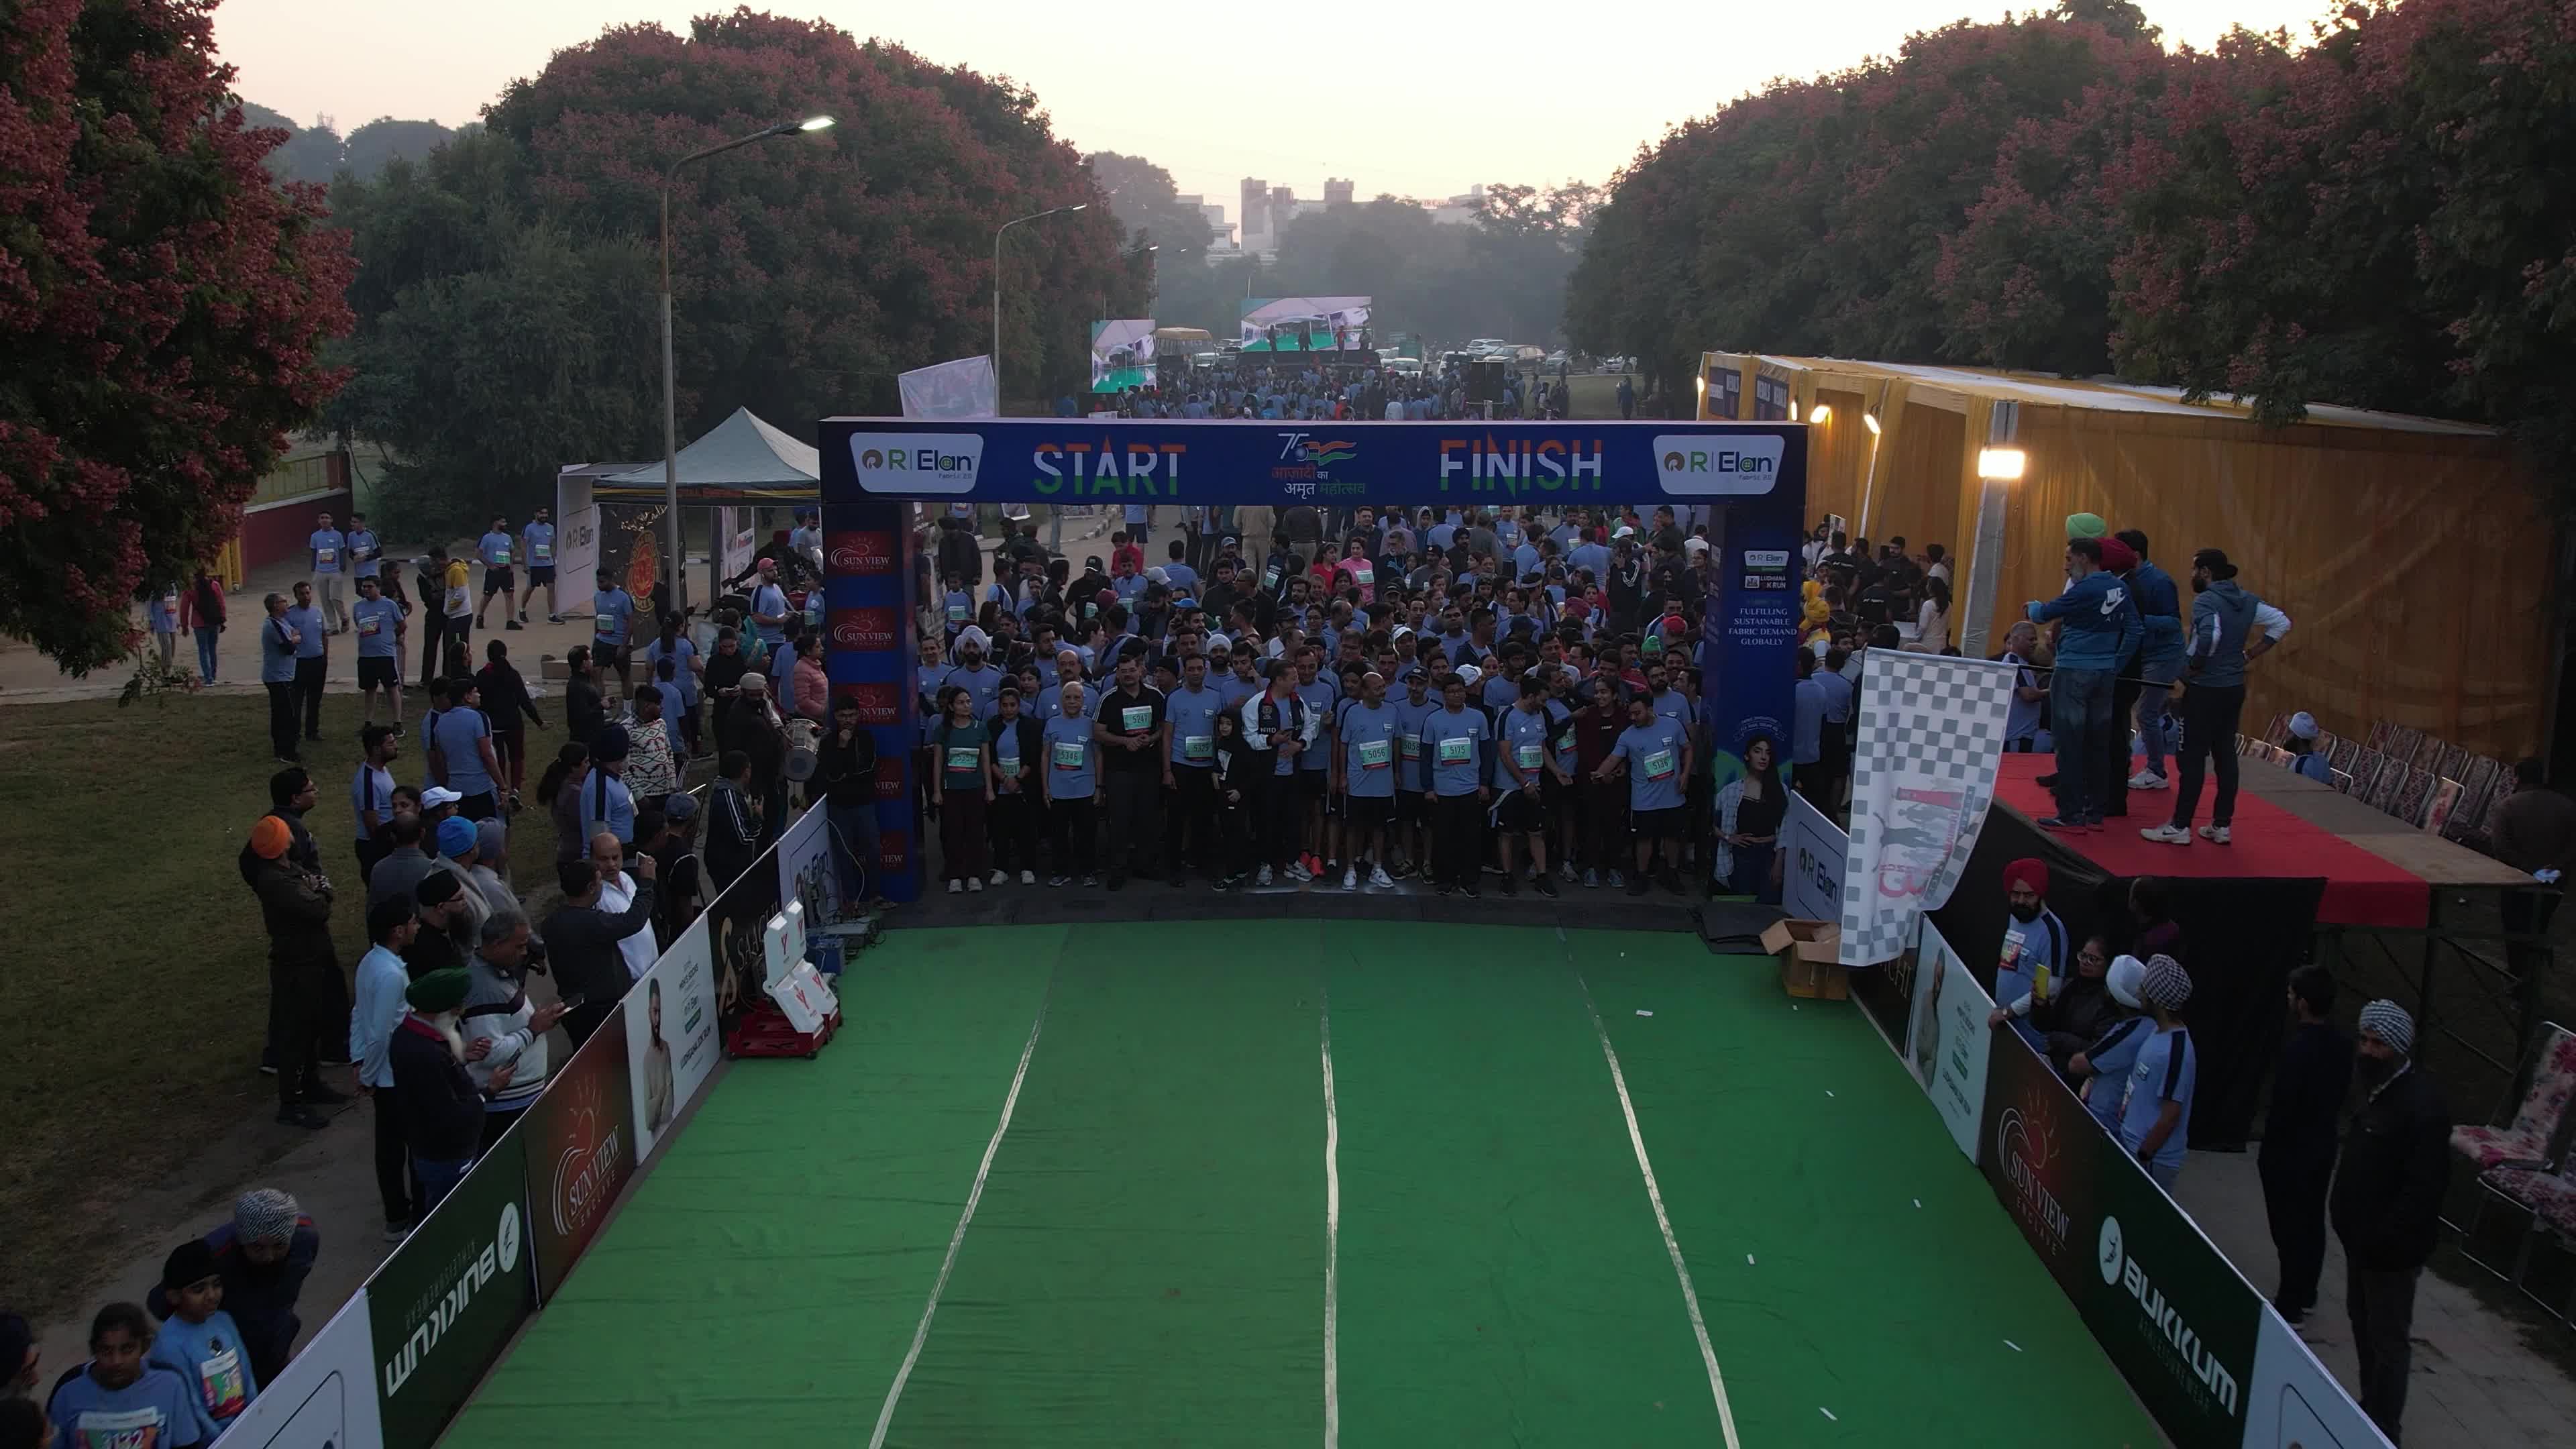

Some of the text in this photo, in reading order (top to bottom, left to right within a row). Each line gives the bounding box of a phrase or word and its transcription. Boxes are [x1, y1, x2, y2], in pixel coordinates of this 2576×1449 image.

[1032, 434, 1187, 495] START
[1316, 471, 1330, 480] का
[1440, 429, 1603, 499] FINISH
[1284, 482, 1316, 499] अमृत
[843, 556, 891, 565] SUN VIEW
[1739, 608, 1788, 616] FULFILLING
[847, 633, 867, 641] SUN
[871, 707, 896, 715] VIEW
[569, 1123, 619, 1218] SUN VIEW
[2010, 1150, 2070, 1241] SUN VIEW
[385, 1240, 496, 1399] BUKKUM
[2123, 1254, 2238, 1417] BUKKUM
